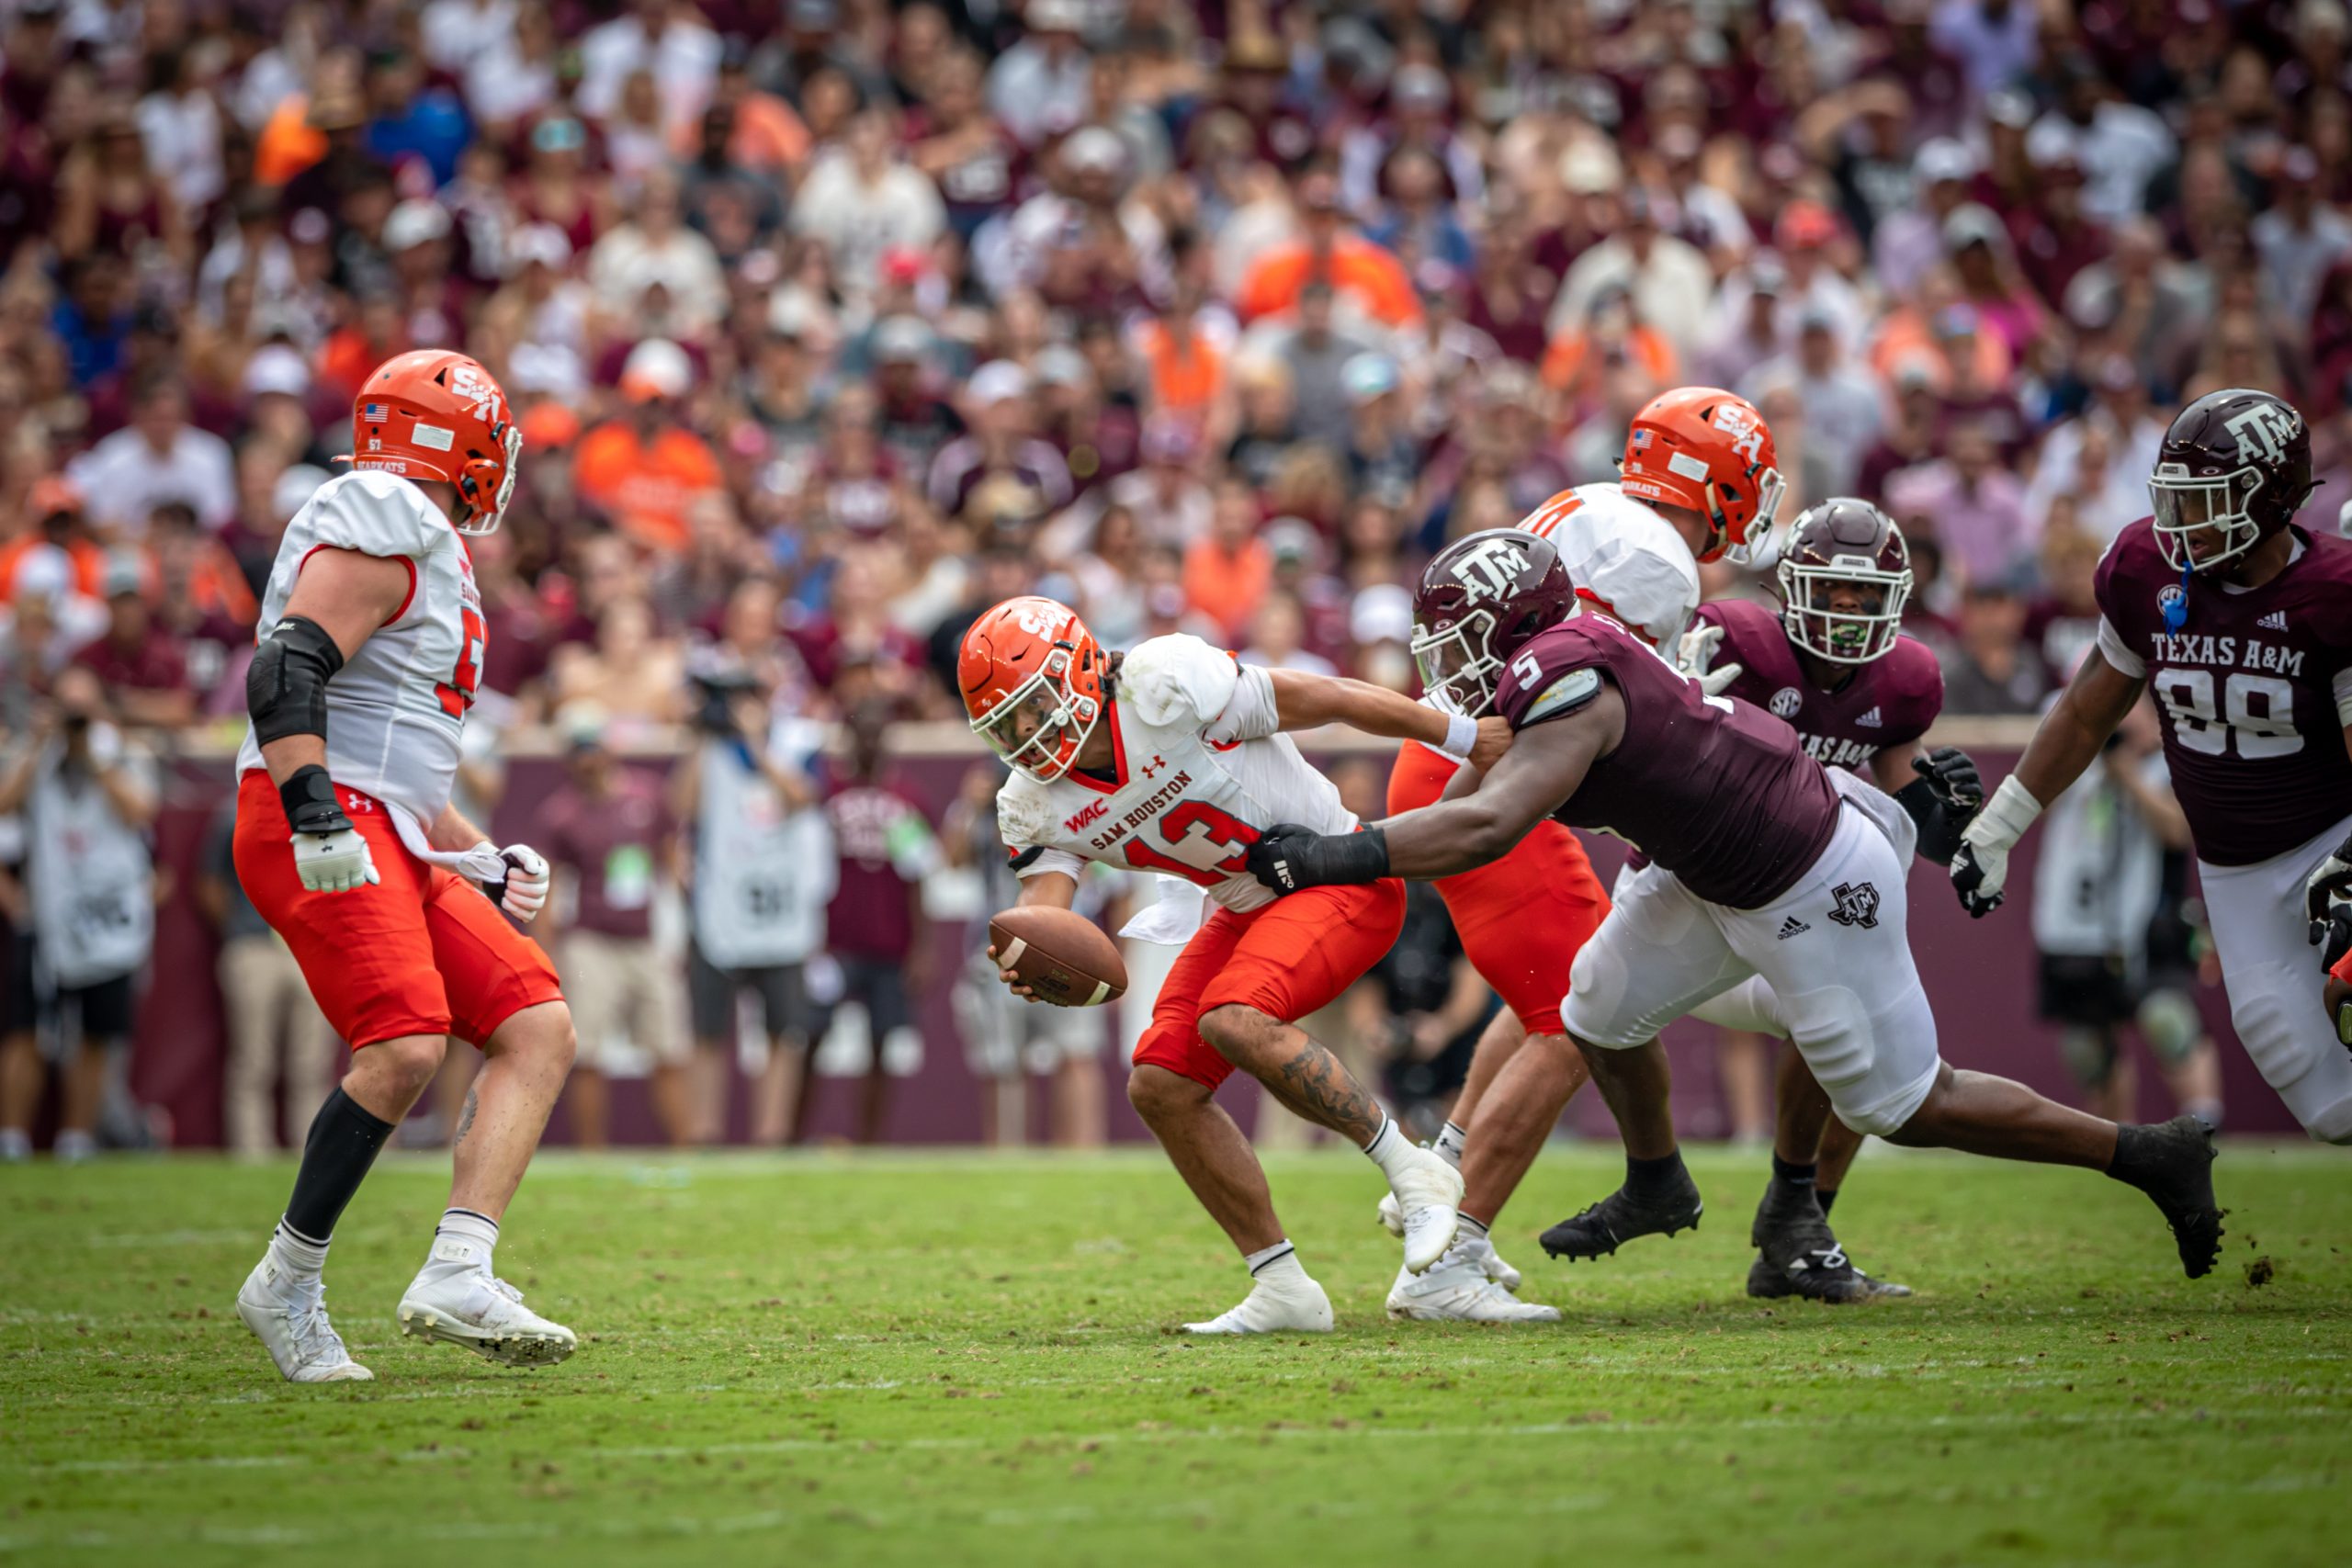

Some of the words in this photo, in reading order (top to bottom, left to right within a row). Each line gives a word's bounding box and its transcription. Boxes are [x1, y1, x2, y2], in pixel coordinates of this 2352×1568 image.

[369, 438, 381, 450] 57
[2256, 618, 2289, 632] adidas
[434, 606, 490, 721] 5
[1511, 649, 1543, 690] 5
[2151, 633, 2236, 665] TEXAS
[2243, 640, 2304, 676] A&M
[1772, 691, 1801, 716] SEC
[1064, 798, 1110, 835] WAC
[1091, 821, 1128, 850] SAM
[1123, 770, 1193, 829] HOUSTON
[1122, 798, 1263, 887] 13
[1777, 923, 1811, 940] adidas
